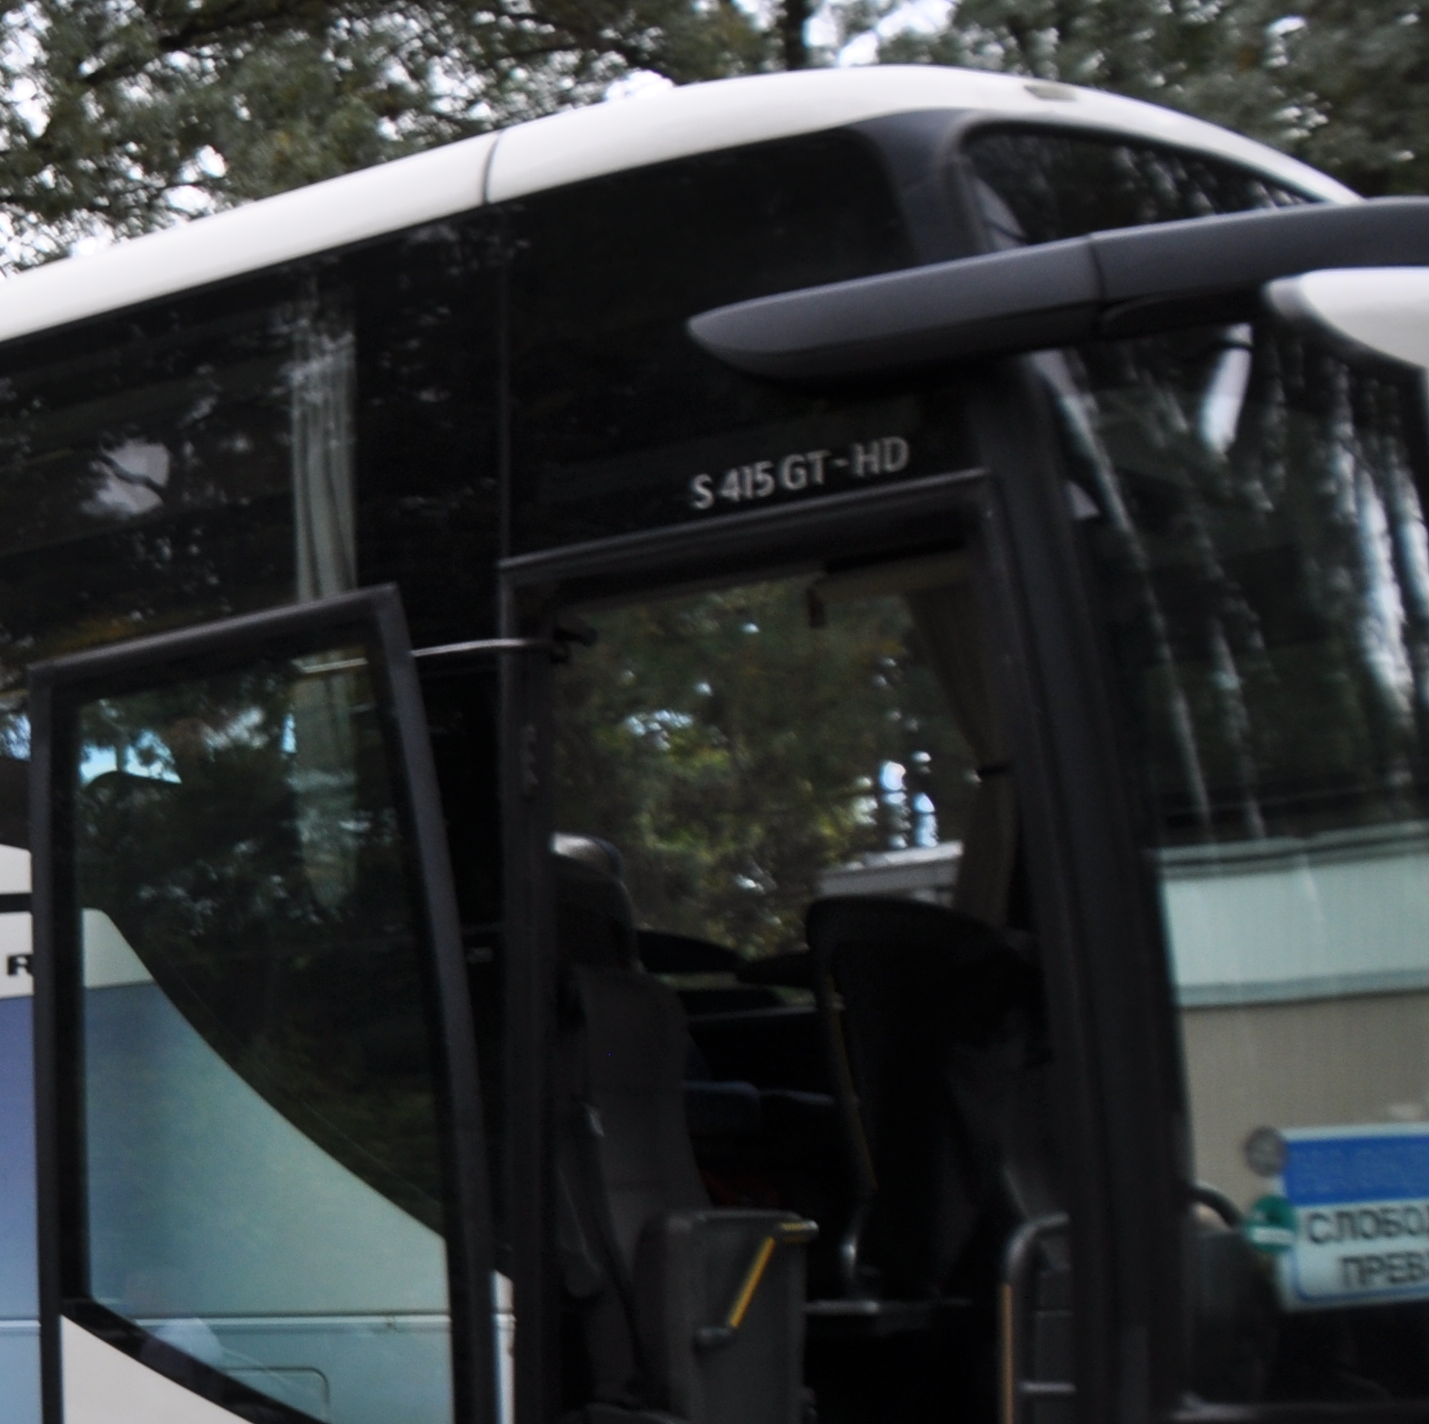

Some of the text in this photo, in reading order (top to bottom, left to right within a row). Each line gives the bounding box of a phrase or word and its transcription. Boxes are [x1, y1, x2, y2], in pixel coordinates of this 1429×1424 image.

[692, 435, 910, 510] S 415 GT-HD
[1307, 1206, 1429, 1244] СЛОБО
[1342, 1251, 1429, 1288] ПРЕВ
